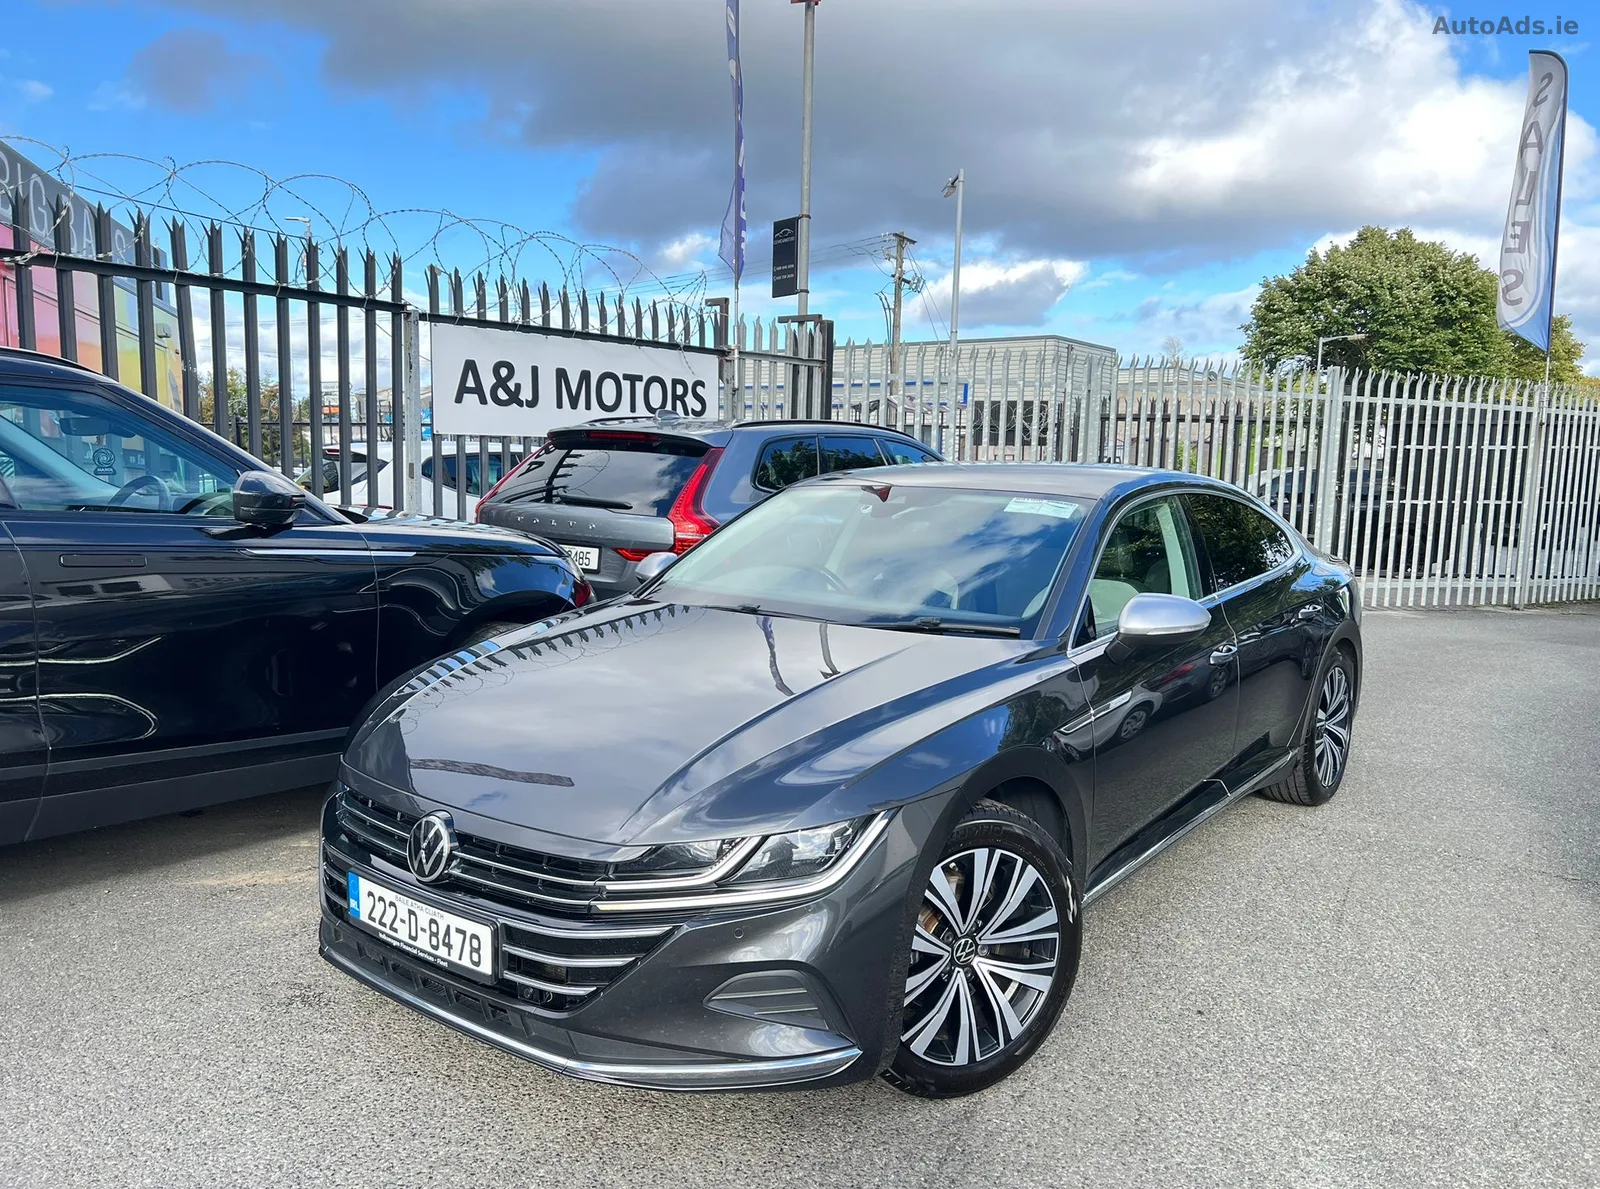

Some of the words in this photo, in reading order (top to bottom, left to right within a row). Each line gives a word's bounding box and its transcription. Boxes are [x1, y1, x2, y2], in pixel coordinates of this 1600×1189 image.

[454, 359, 539, 408] A&J
[555, 367, 707, 417] MOTORS
[367, 890, 481, 968] 222-D-8478
